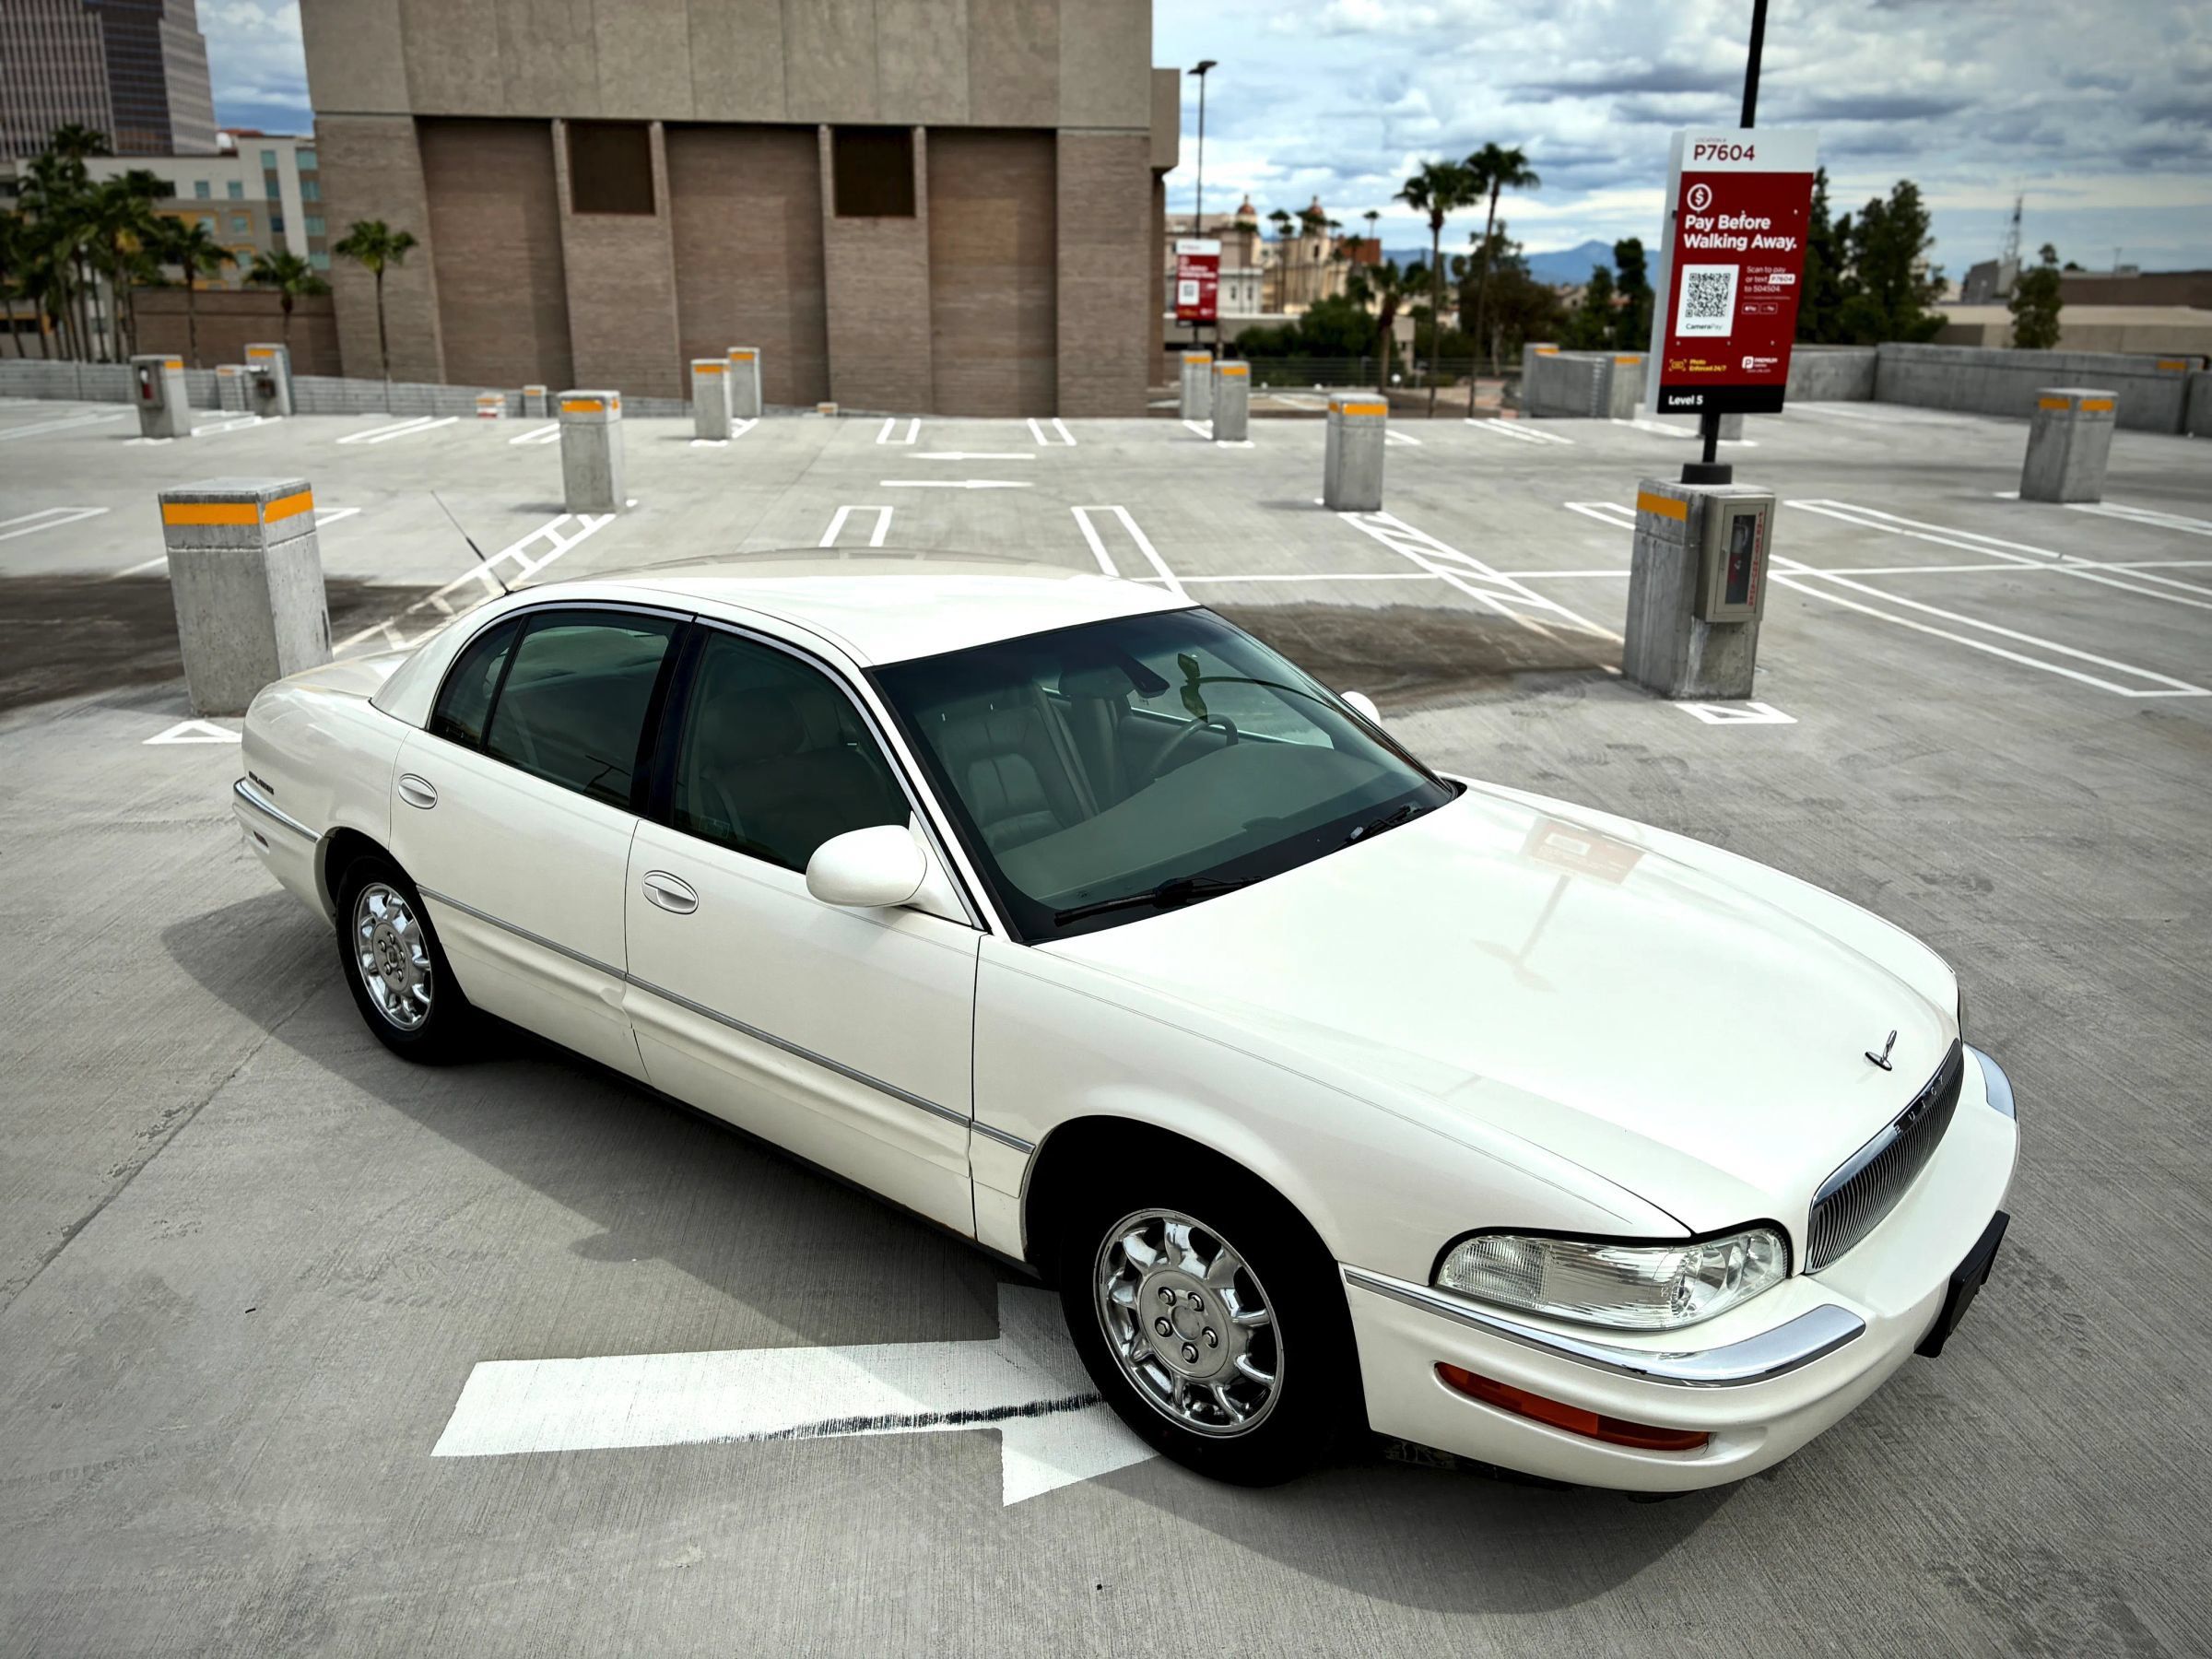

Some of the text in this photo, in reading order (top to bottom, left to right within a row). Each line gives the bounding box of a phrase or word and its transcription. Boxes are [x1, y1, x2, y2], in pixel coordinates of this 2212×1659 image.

[1693, 144, 1755, 161] P7604
[1685, 213, 1771, 232] Pay Before
[1683, 233, 1797, 252] Walking Away.
[1747, 265, 1763, 274] Scan
[1764, 265, 1771, 274] to
[1668, 394, 1704, 406] Level 5
